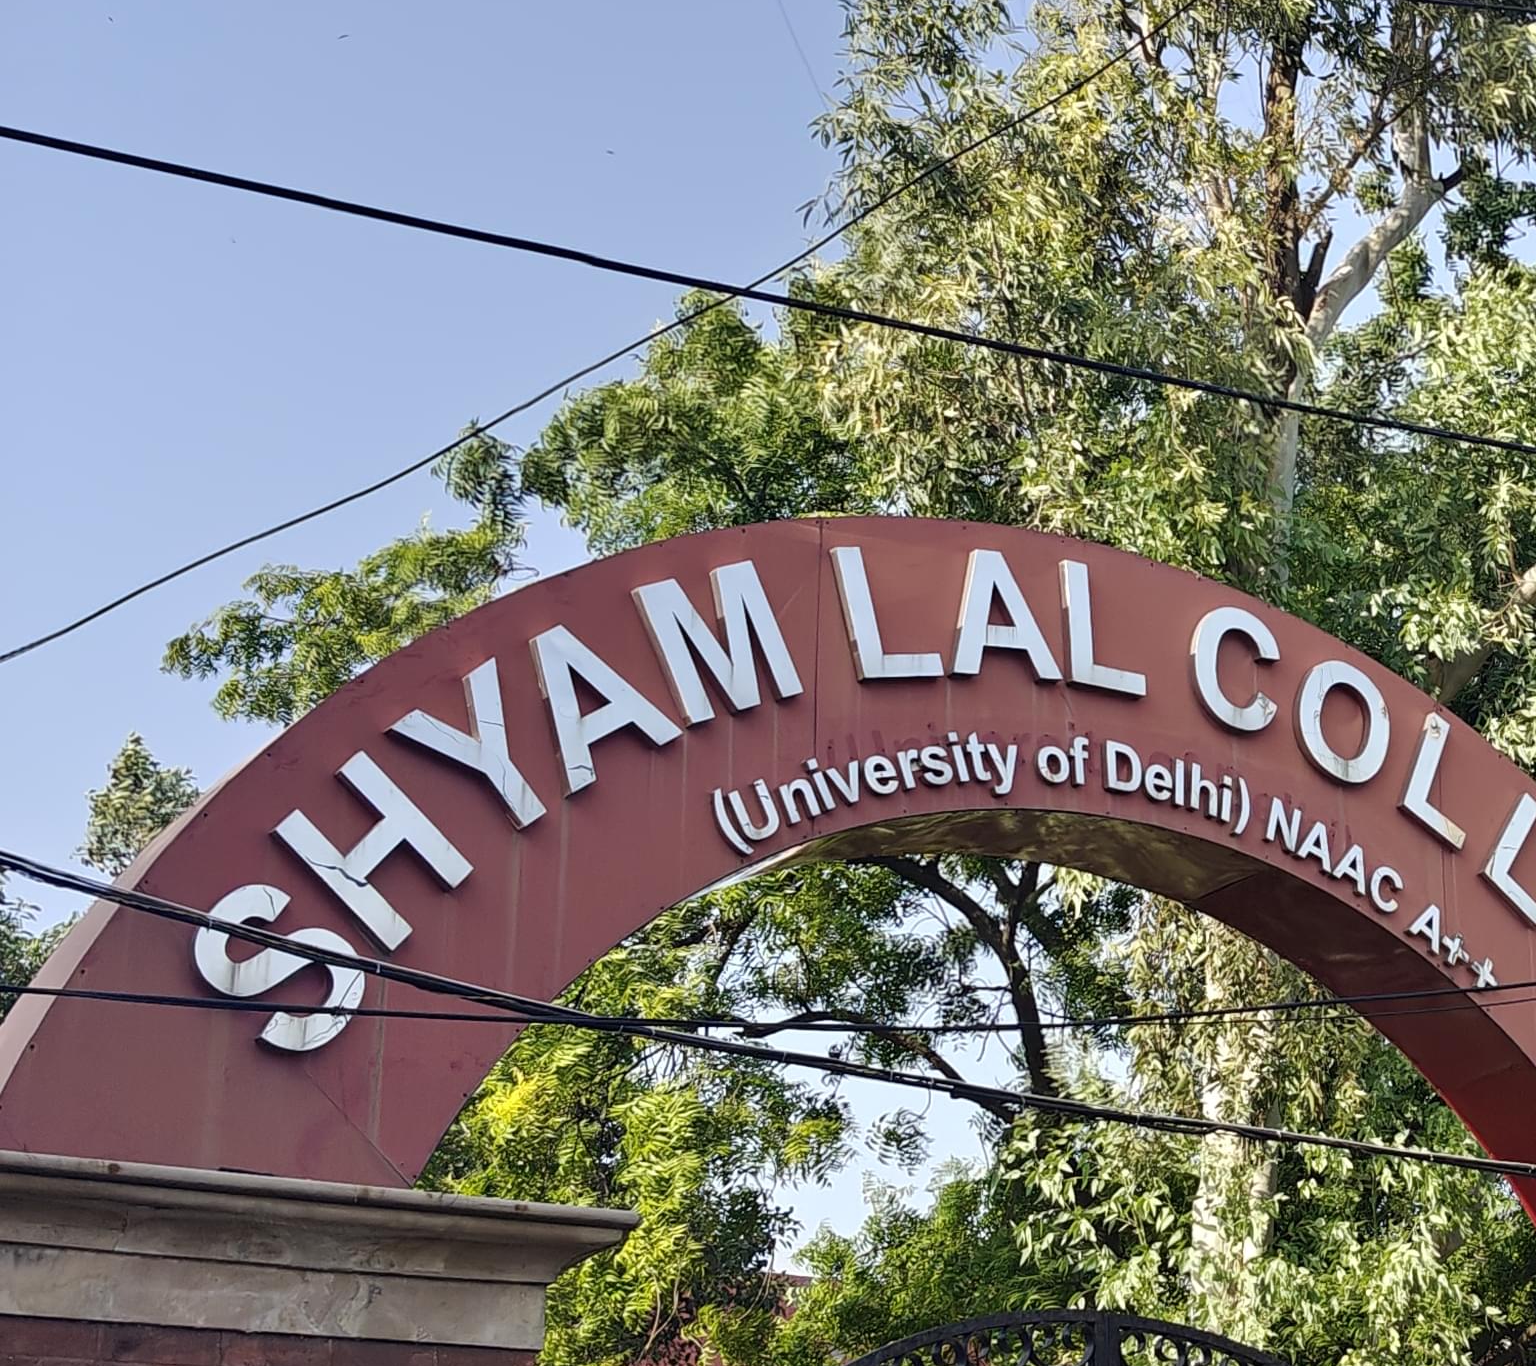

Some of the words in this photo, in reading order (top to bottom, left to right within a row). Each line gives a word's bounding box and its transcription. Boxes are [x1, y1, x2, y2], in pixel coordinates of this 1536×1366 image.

[193, 560, 803, 1053] SHYAM
[831, 546, 1148, 699] LAL
[712, 727, 1018, 852] (University
[1038, 734, 1089, 788] of
[1101, 737, 1252, 837] Delhi)
[1264, 802, 1405, 914] NAAC
[1411, 900, 1499, 990] A++
